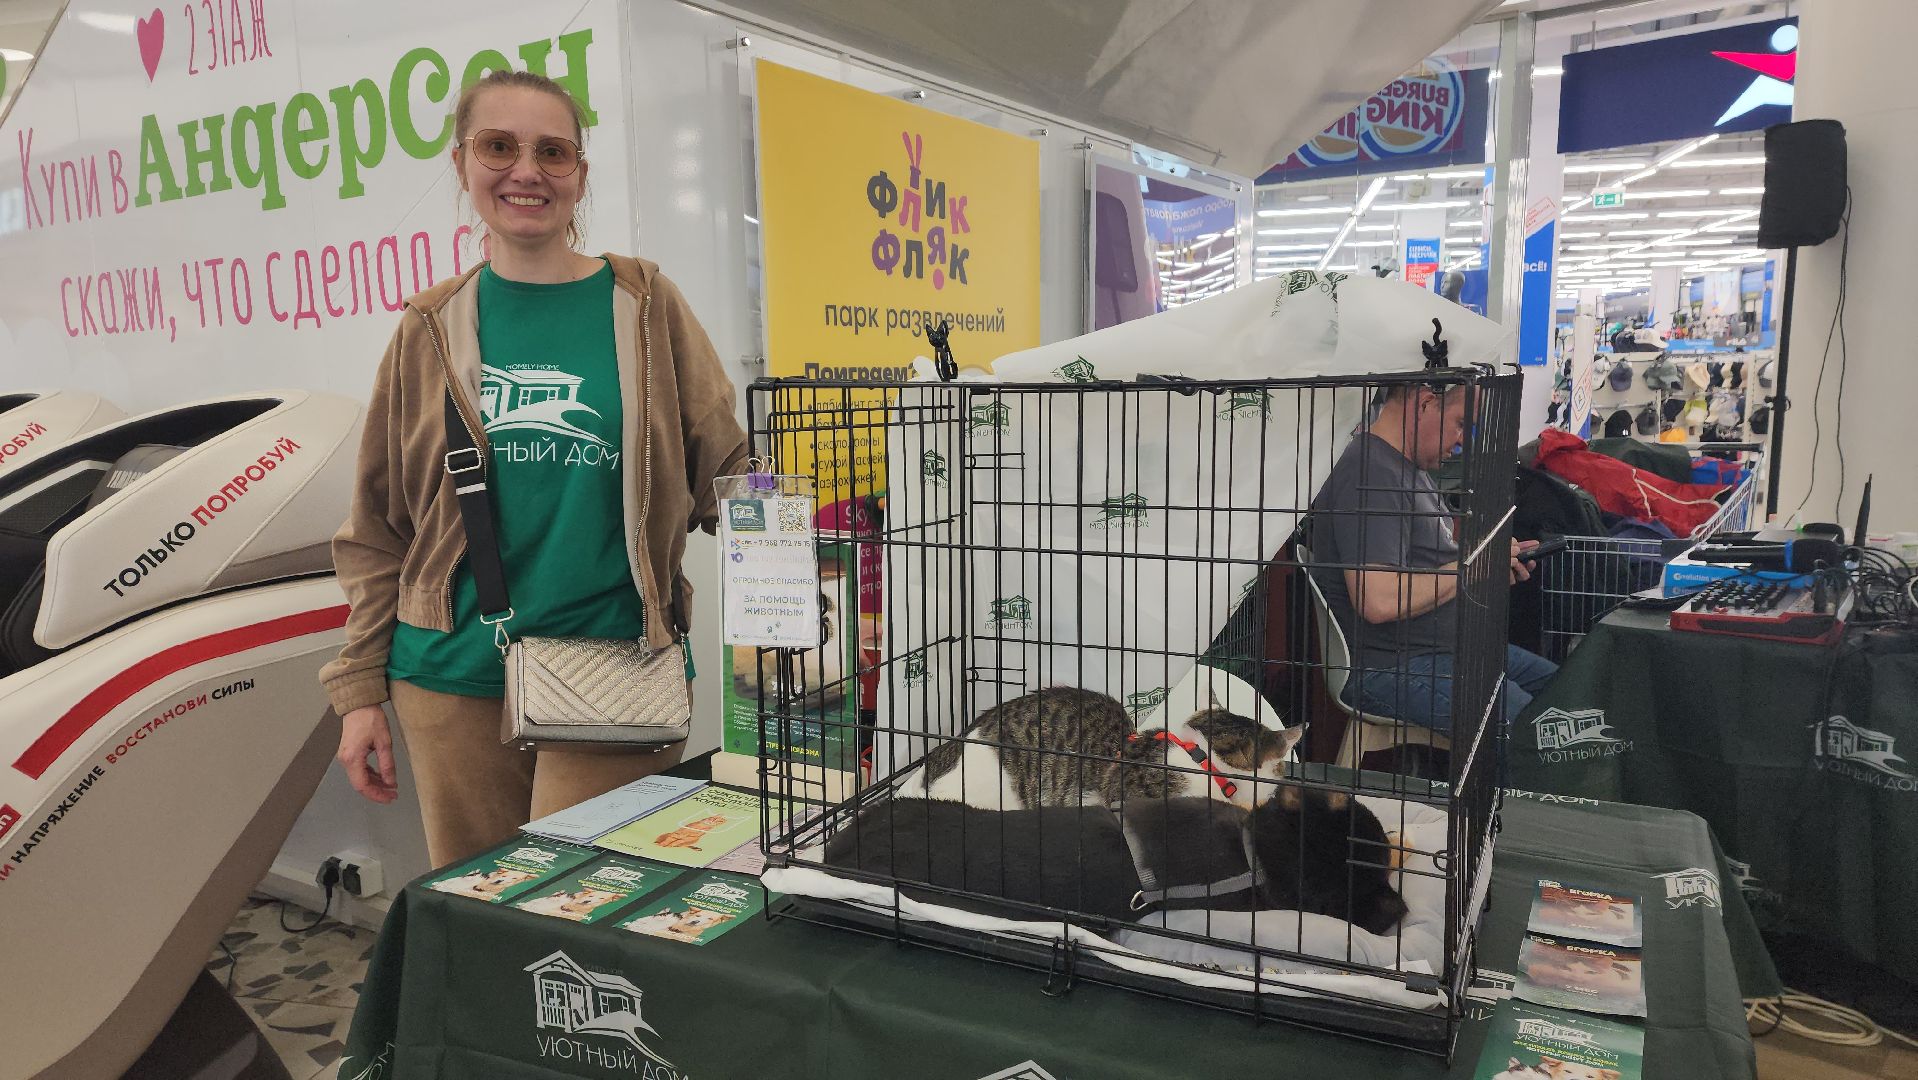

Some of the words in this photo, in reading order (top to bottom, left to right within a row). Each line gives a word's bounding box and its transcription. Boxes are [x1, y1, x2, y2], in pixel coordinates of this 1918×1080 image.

[185, 4, 199, 75] 2
[202, 0, 272, 70] ЭТАЖ
[18, 127, 101, 230] Купи
[108, 149, 129, 215] в
[866, 170, 970, 234] ФЛИК
[871, 226, 970, 286] ФЛЯК
[60, 265, 178, 343] скажи,
[182, 250, 252, 330] что
[264, 231, 435, 331] сделал
[824, 304, 879, 335] парк
[886, 308, 1005, 337] развлечений
[0, 421, 48, 464] ОБУЙ
[488, 436, 556, 463] НЫЙ
[565, 441, 620, 470] ДОМ
[819, 470, 877, 492] аэрохккей
[103, 520, 196, 599] ТОЛЬКО
[190, 436, 302, 528] ПОПРОБУЙ
[776, 577, 814, 586] СПАСИБО
[743, 595, 756, 603] ЗА
[759, 595, 806, 606] ПОМОЩЬ
[743, 607, 804, 617] ЖИВОТНЫМ
[10, 765, 106, 864] НАПРЯЖЕНИЕ
[105, 694, 209, 765] ВОССТАНОВИ
[210, 677, 256, 703] СИЛЫ
[1538, 746, 1602, 765] УЮТНЫЙ
[1603, 740, 1634, 757] ДОМ
[1883, 776, 1918, 793] ДО
[536, 1034, 639, 1073] УЮТНЫЙ
[1515, 1033, 1581, 1052] УЮТНЫЙ
